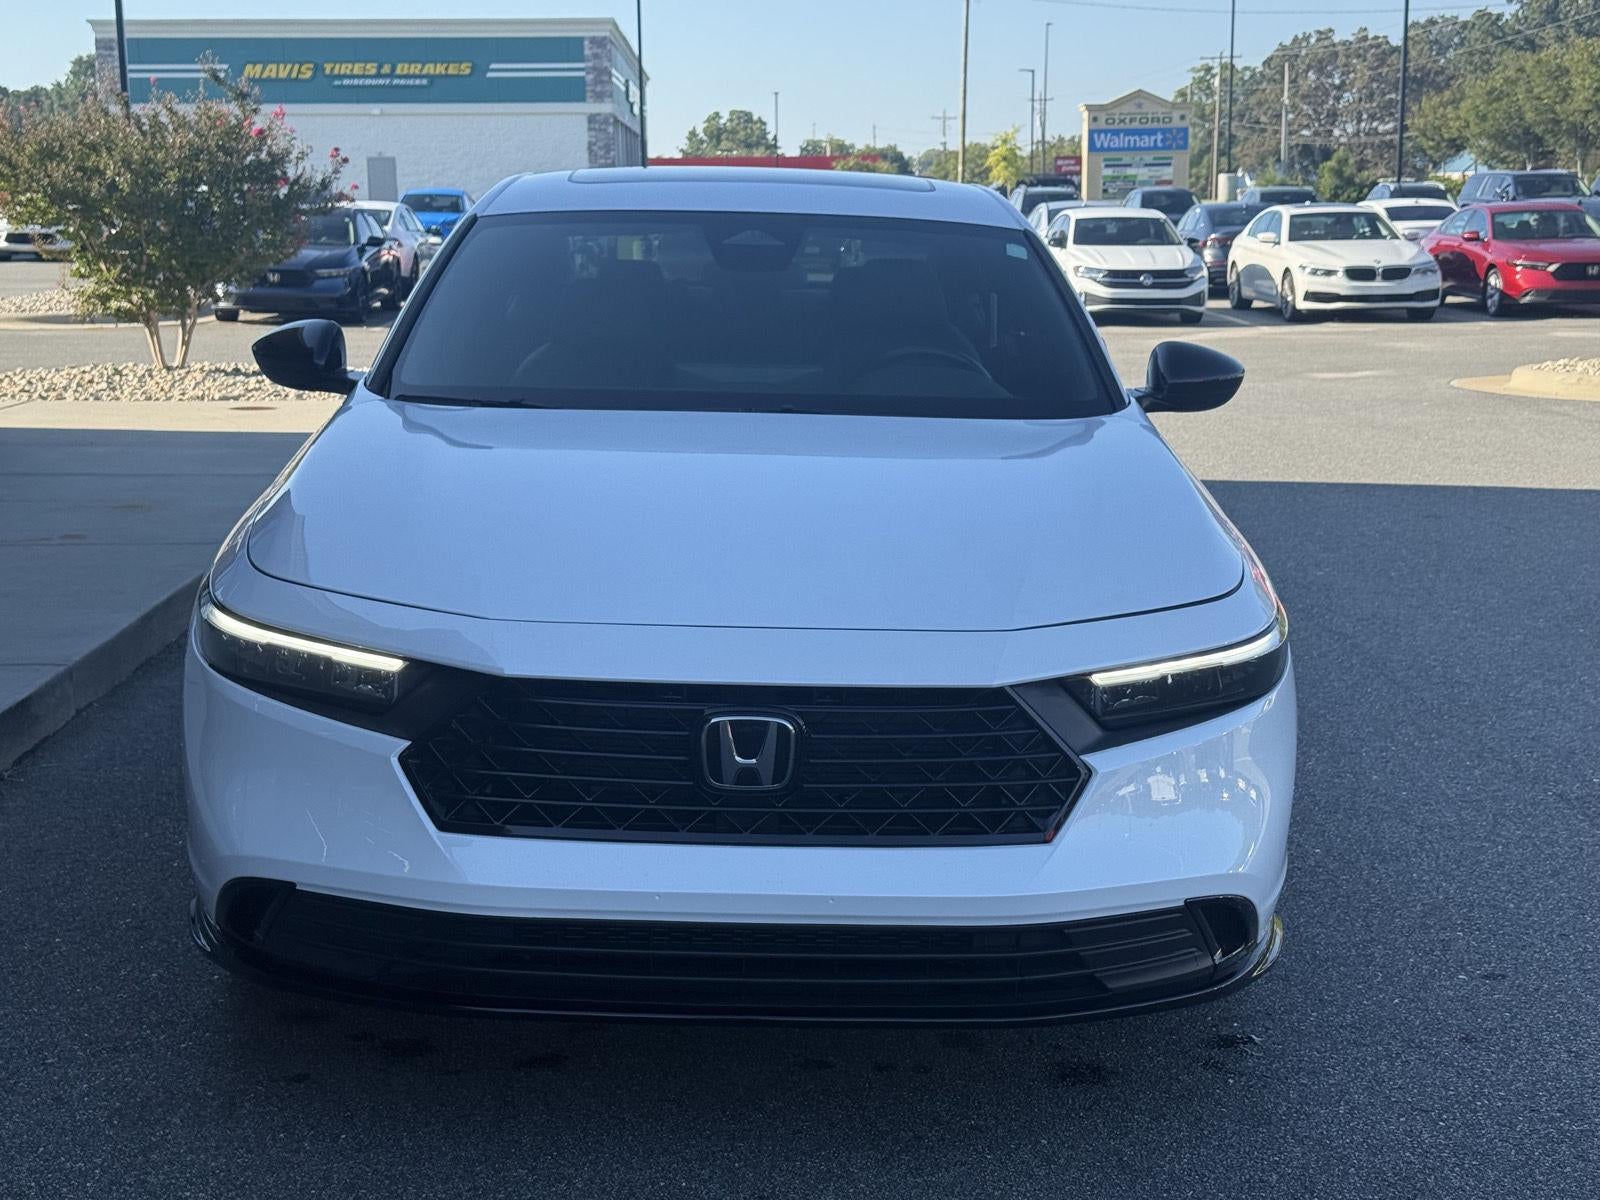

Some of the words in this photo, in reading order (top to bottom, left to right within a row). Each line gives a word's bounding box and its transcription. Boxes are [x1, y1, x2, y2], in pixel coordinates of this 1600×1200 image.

[244, 63, 314, 79] MAVIS
[323, 62, 378, 75] TIRES
[395, 62, 472, 75] BRAKES
[342, 78, 391, 86] DISCOUNT
[1105, 116, 1173, 126] OXFORD
[1094, 131, 1164, 149] Walmart
